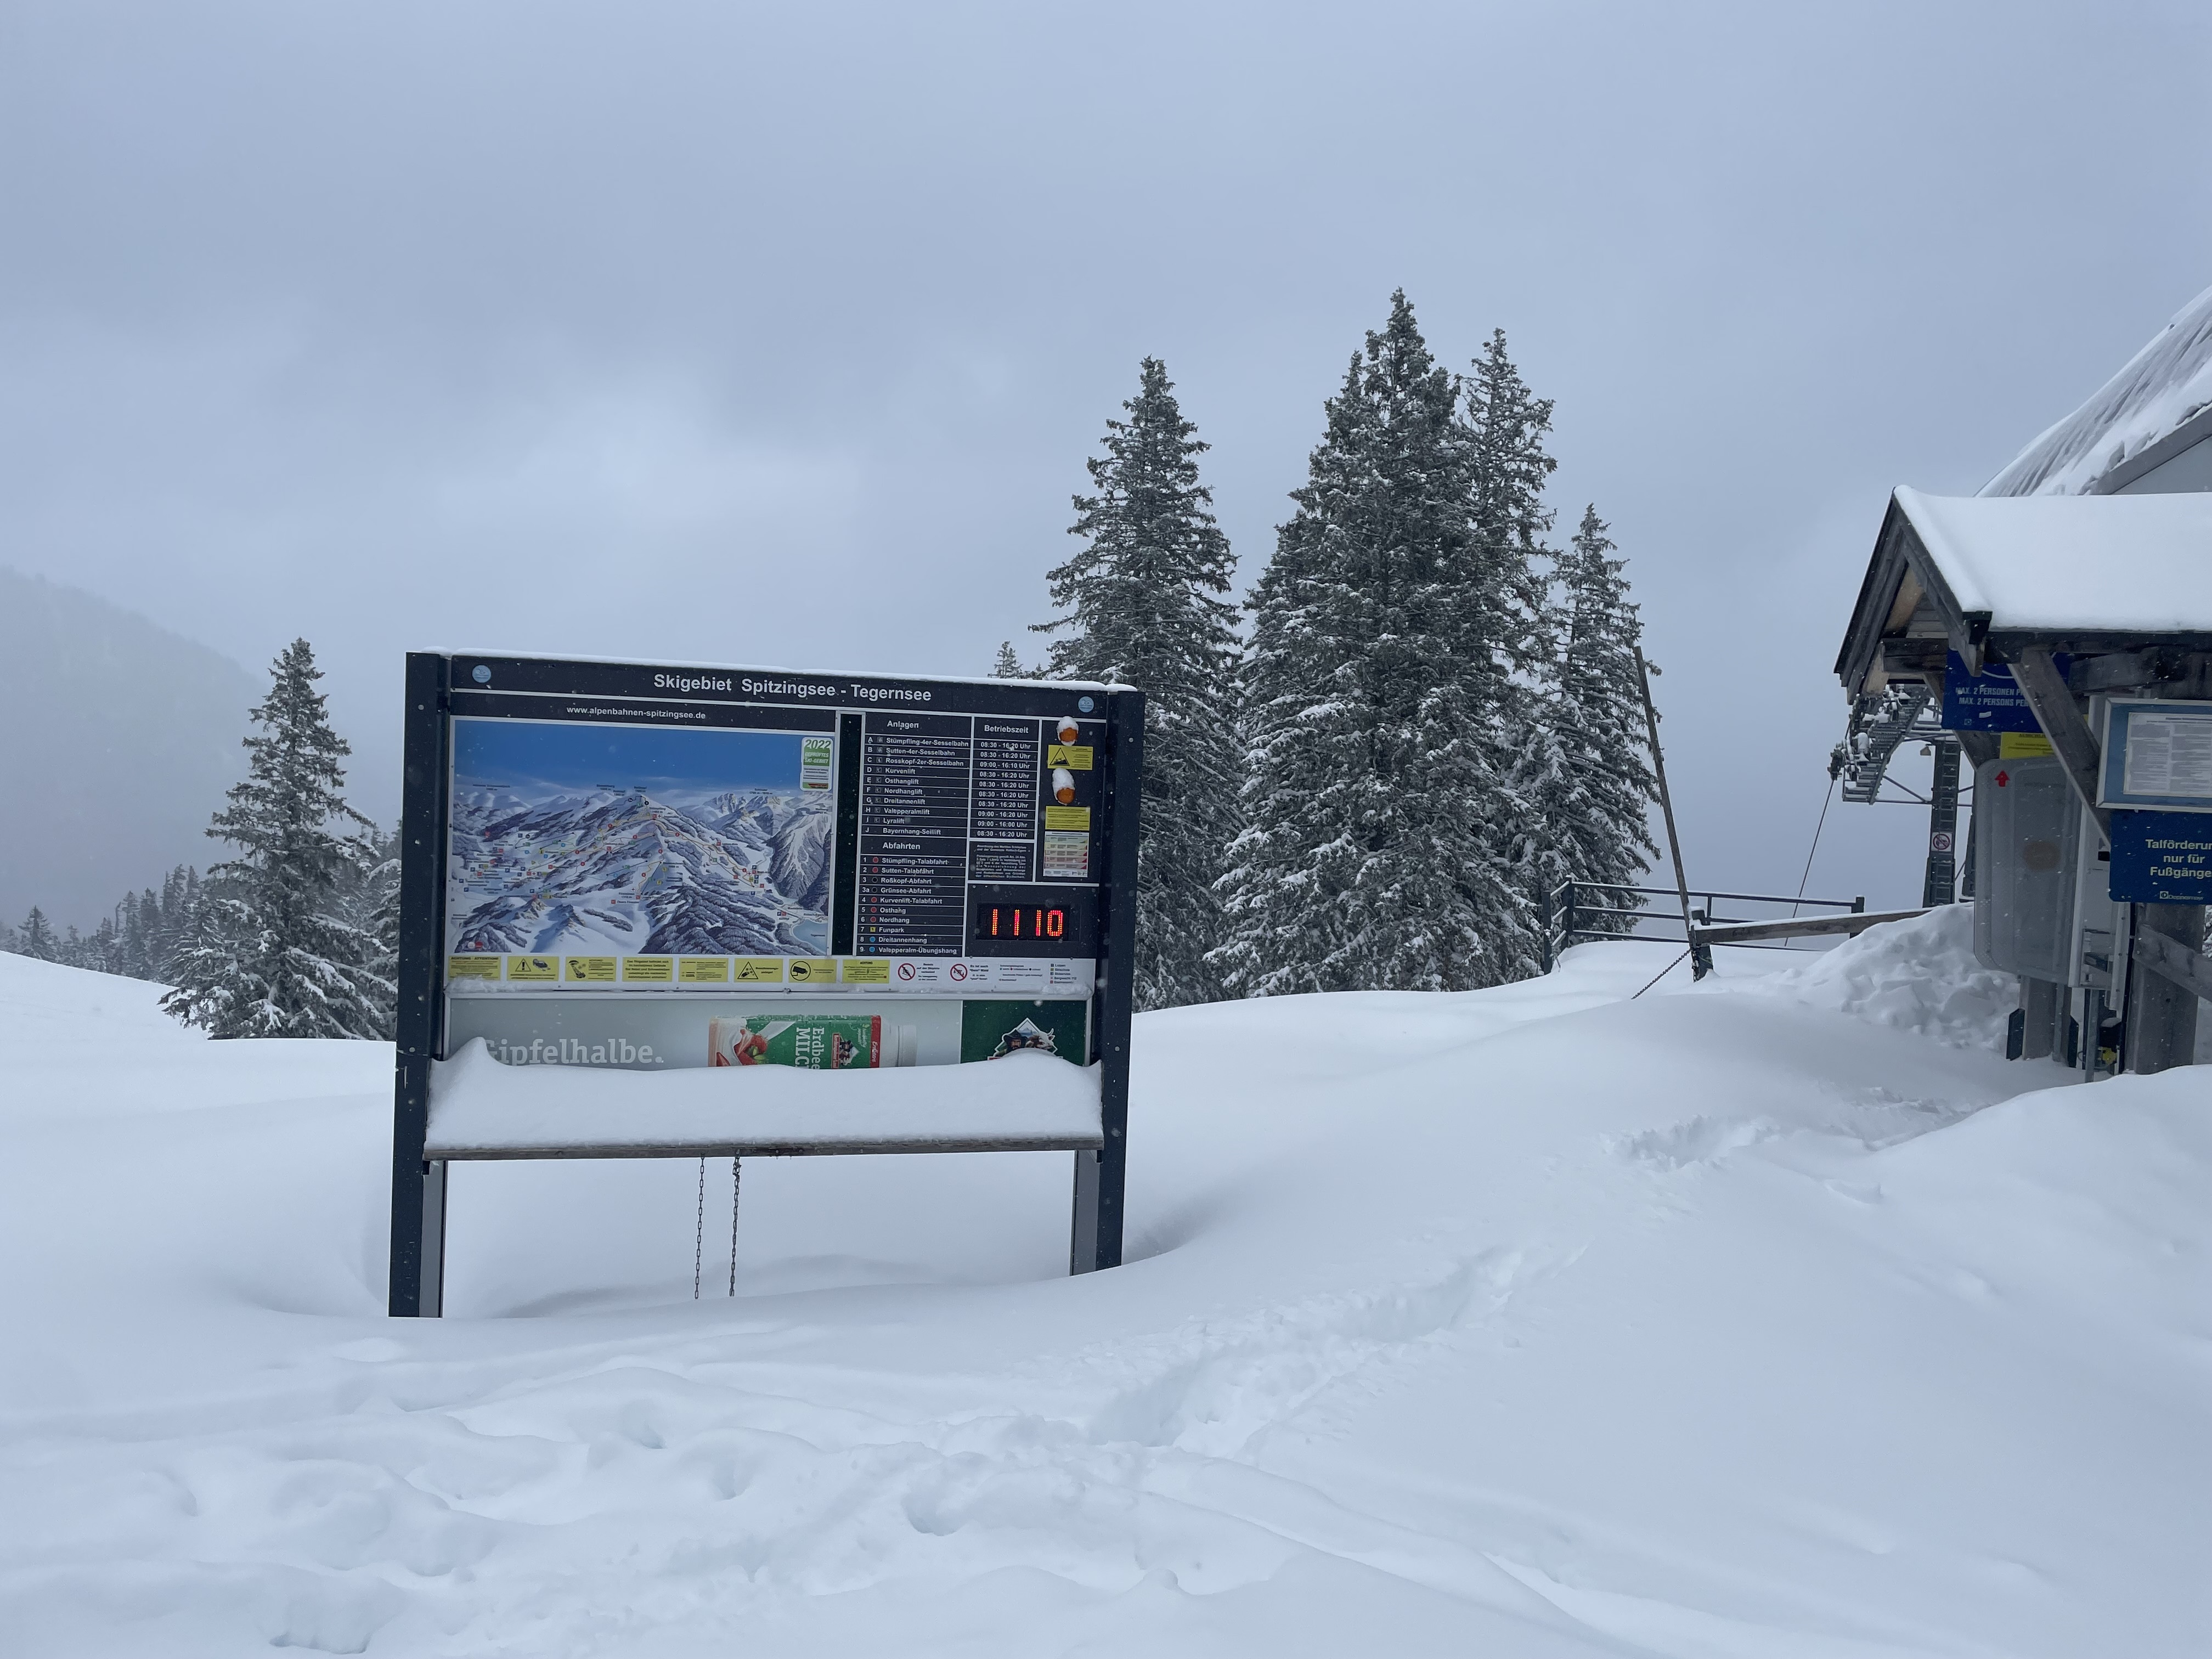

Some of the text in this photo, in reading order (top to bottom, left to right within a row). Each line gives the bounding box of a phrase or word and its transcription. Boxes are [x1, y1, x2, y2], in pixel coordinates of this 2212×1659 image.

[654, 674, 732, 692] Skigebiet
[741, 678, 836, 698] Spitzingsee
[850, 684, 932, 702] Tegernsee
[1979, 687, 2015, 696] PERSONEN
[567, 707, 706, 719] www.alpenbahnen-spitzingsee.de
[887, 721, 919, 729] Anlagen
[984, 725, 1029, 733] Betriebszeit
[805, 740, 831, 749] 2022
[886, 738, 969, 746] Stümpfling-4er-Sesselbahn
[886, 748, 955, 756] Sutten-4er-Sesselbahn
[885, 758, 964, 766] Rosskopf-2er-Sesselbahn
[2187, 854, 2205, 864] für
[2150, 866, 2212, 879] Fußgänge
[811, 1028, 825, 1069] Erdbee
